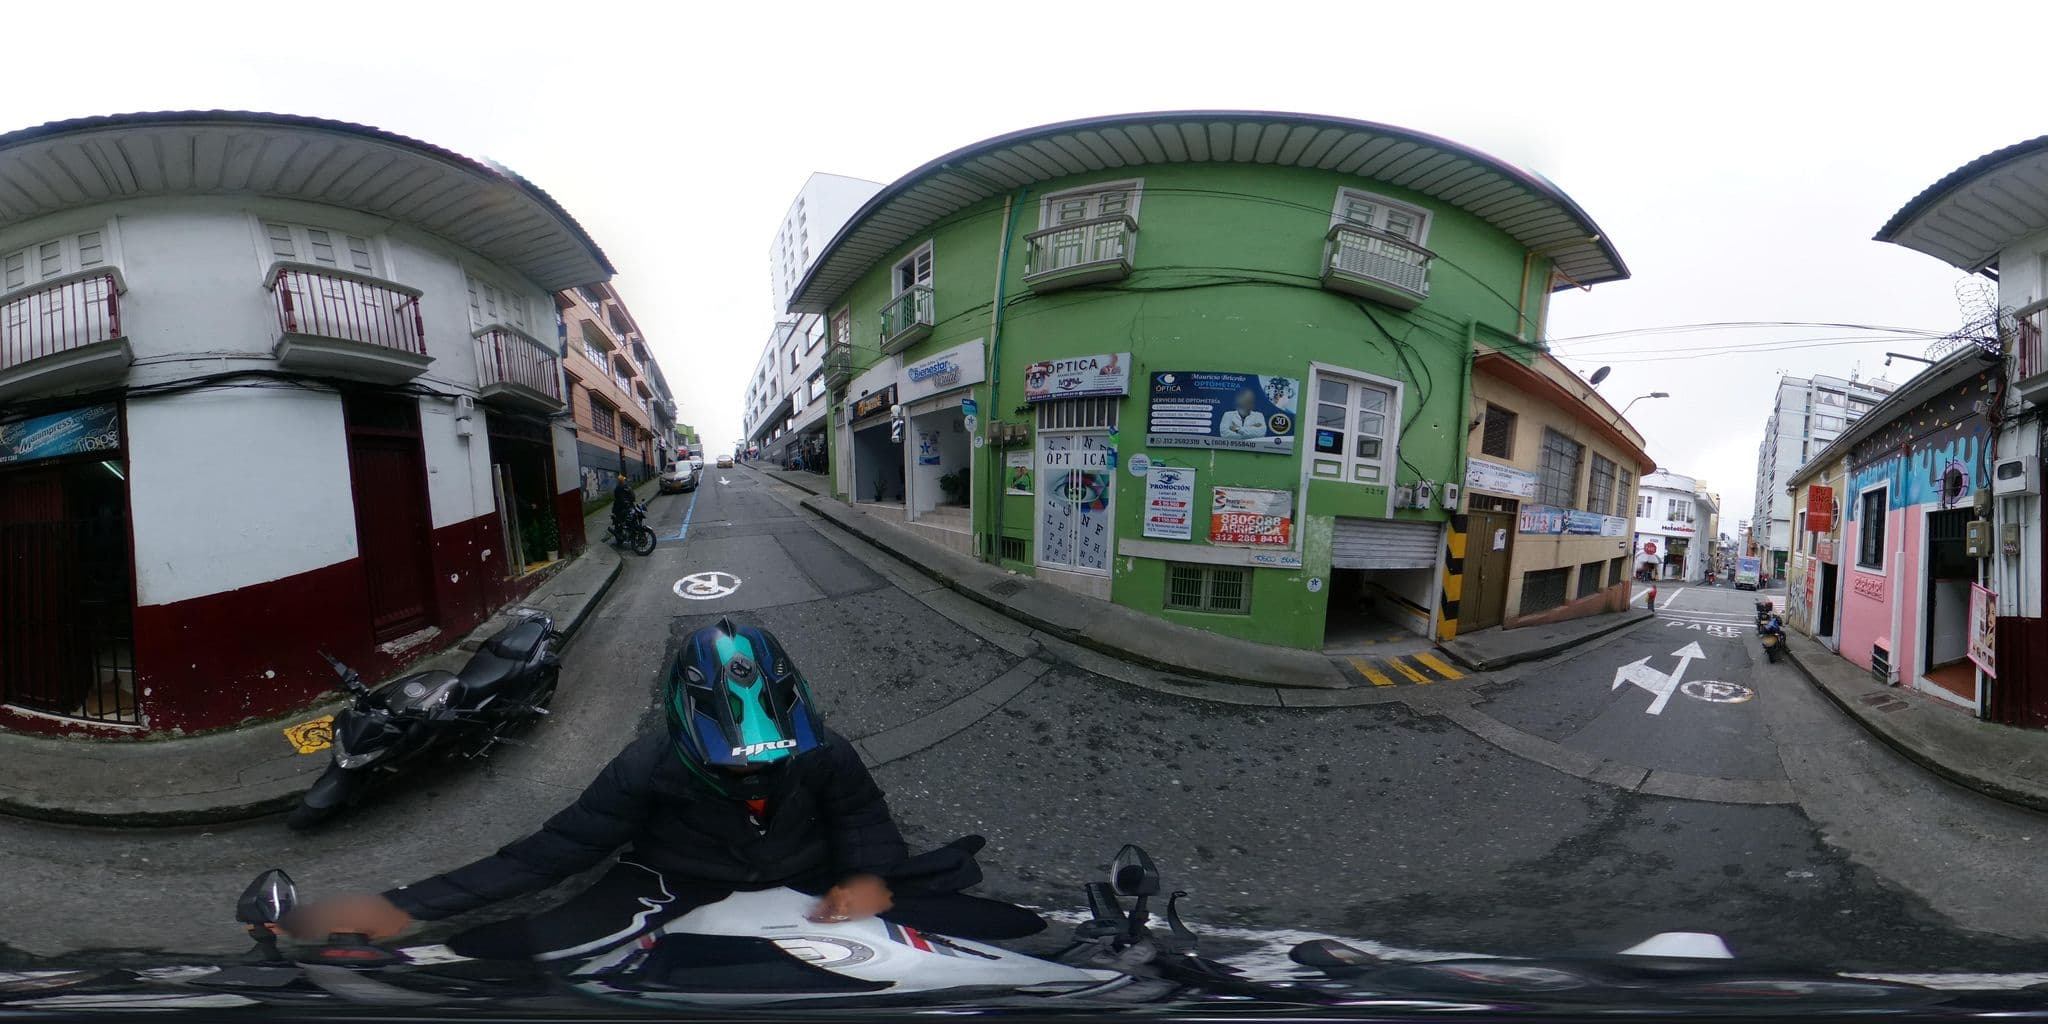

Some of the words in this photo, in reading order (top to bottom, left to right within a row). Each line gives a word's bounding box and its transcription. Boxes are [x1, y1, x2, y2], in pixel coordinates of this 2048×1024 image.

[914, 360, 948, 378] Bienestar
[1275, 416, 1286, 425] 30
[1150, 483, 1191, 492] PROMOCIÓN
[1220, 513, 1281, 526] 8806088
[1220, 523, 1281, 535] ARRIENDA
[1215, 533, 1233, 541] 312
[1238, 534, 1256, 542] 286
[1261, 535, 1285, 543] 8413
[1665, 621, 1742, 635] PARE
[731, 738, 798, 758] HRO
